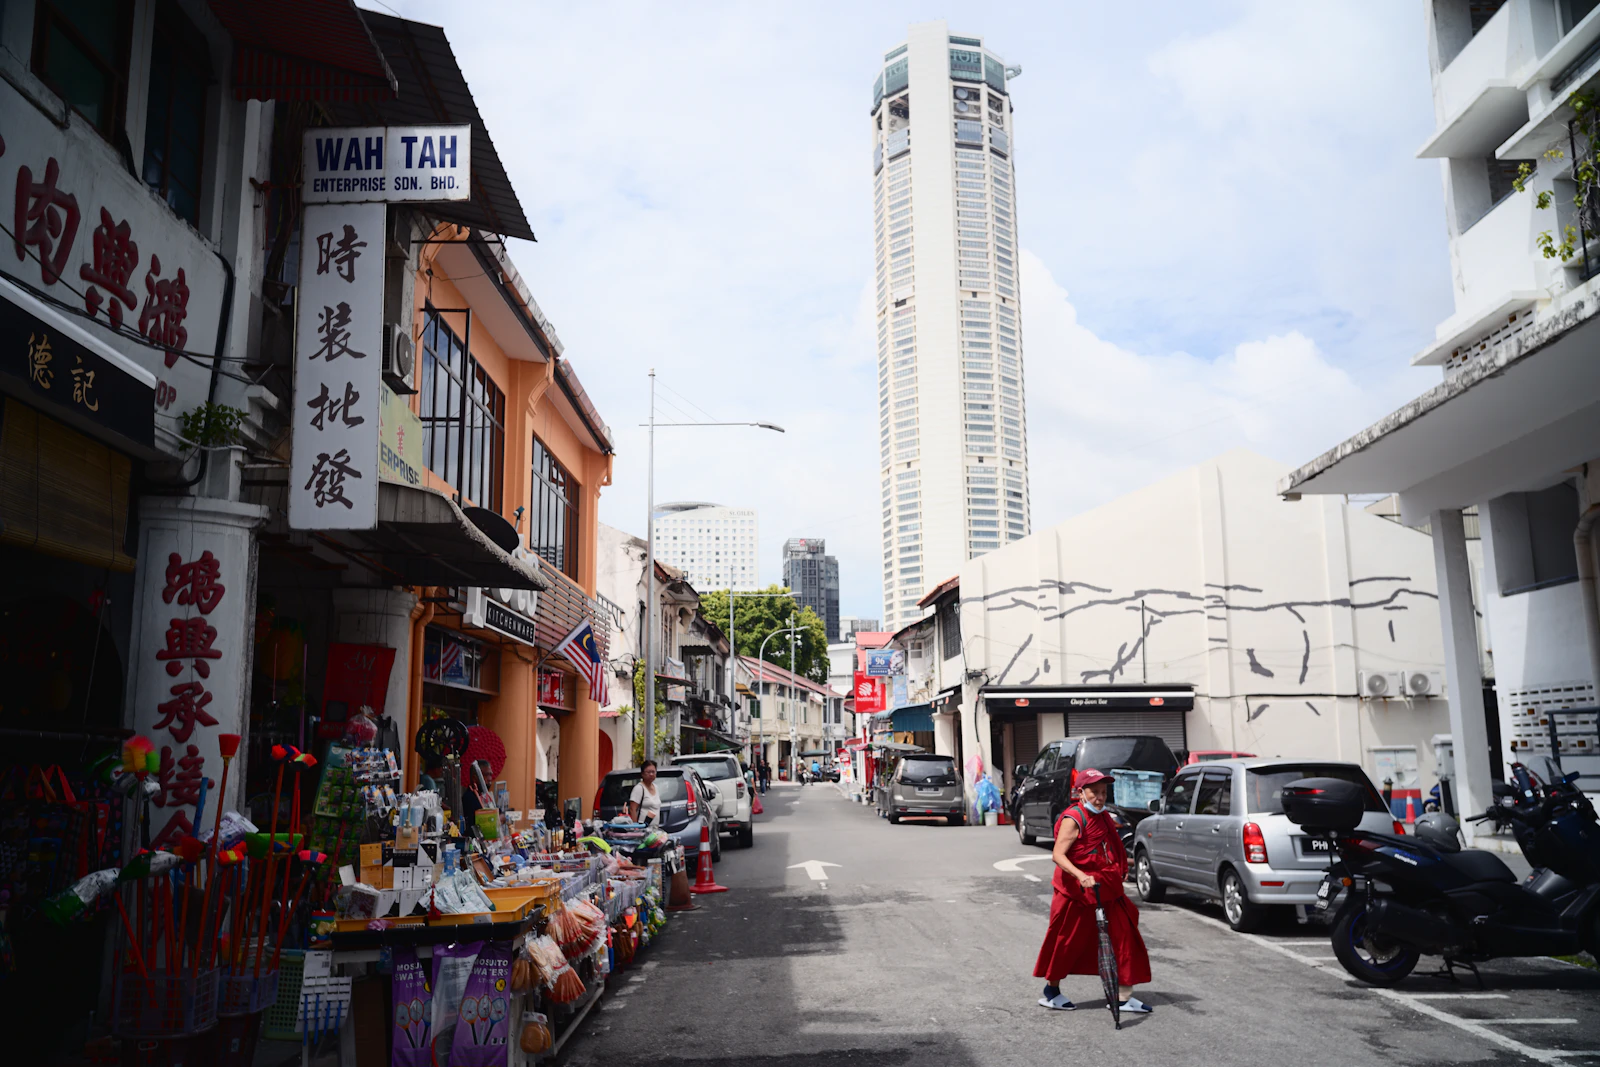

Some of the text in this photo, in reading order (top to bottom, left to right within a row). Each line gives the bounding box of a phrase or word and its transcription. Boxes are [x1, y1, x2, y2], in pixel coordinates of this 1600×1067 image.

[315, 135, 457, 171] WAH TAH
[313, 175, 459, 192] ENTERPRISE SDN. BHD.
[27, 331, 99, 412] 德記
[304, 224, 368, 510] 時裝批發
[155, 380, 177, 410] OP
[487, 607, 534, 640] KITCHENWARE
[875, 657, 885, 665] 96
